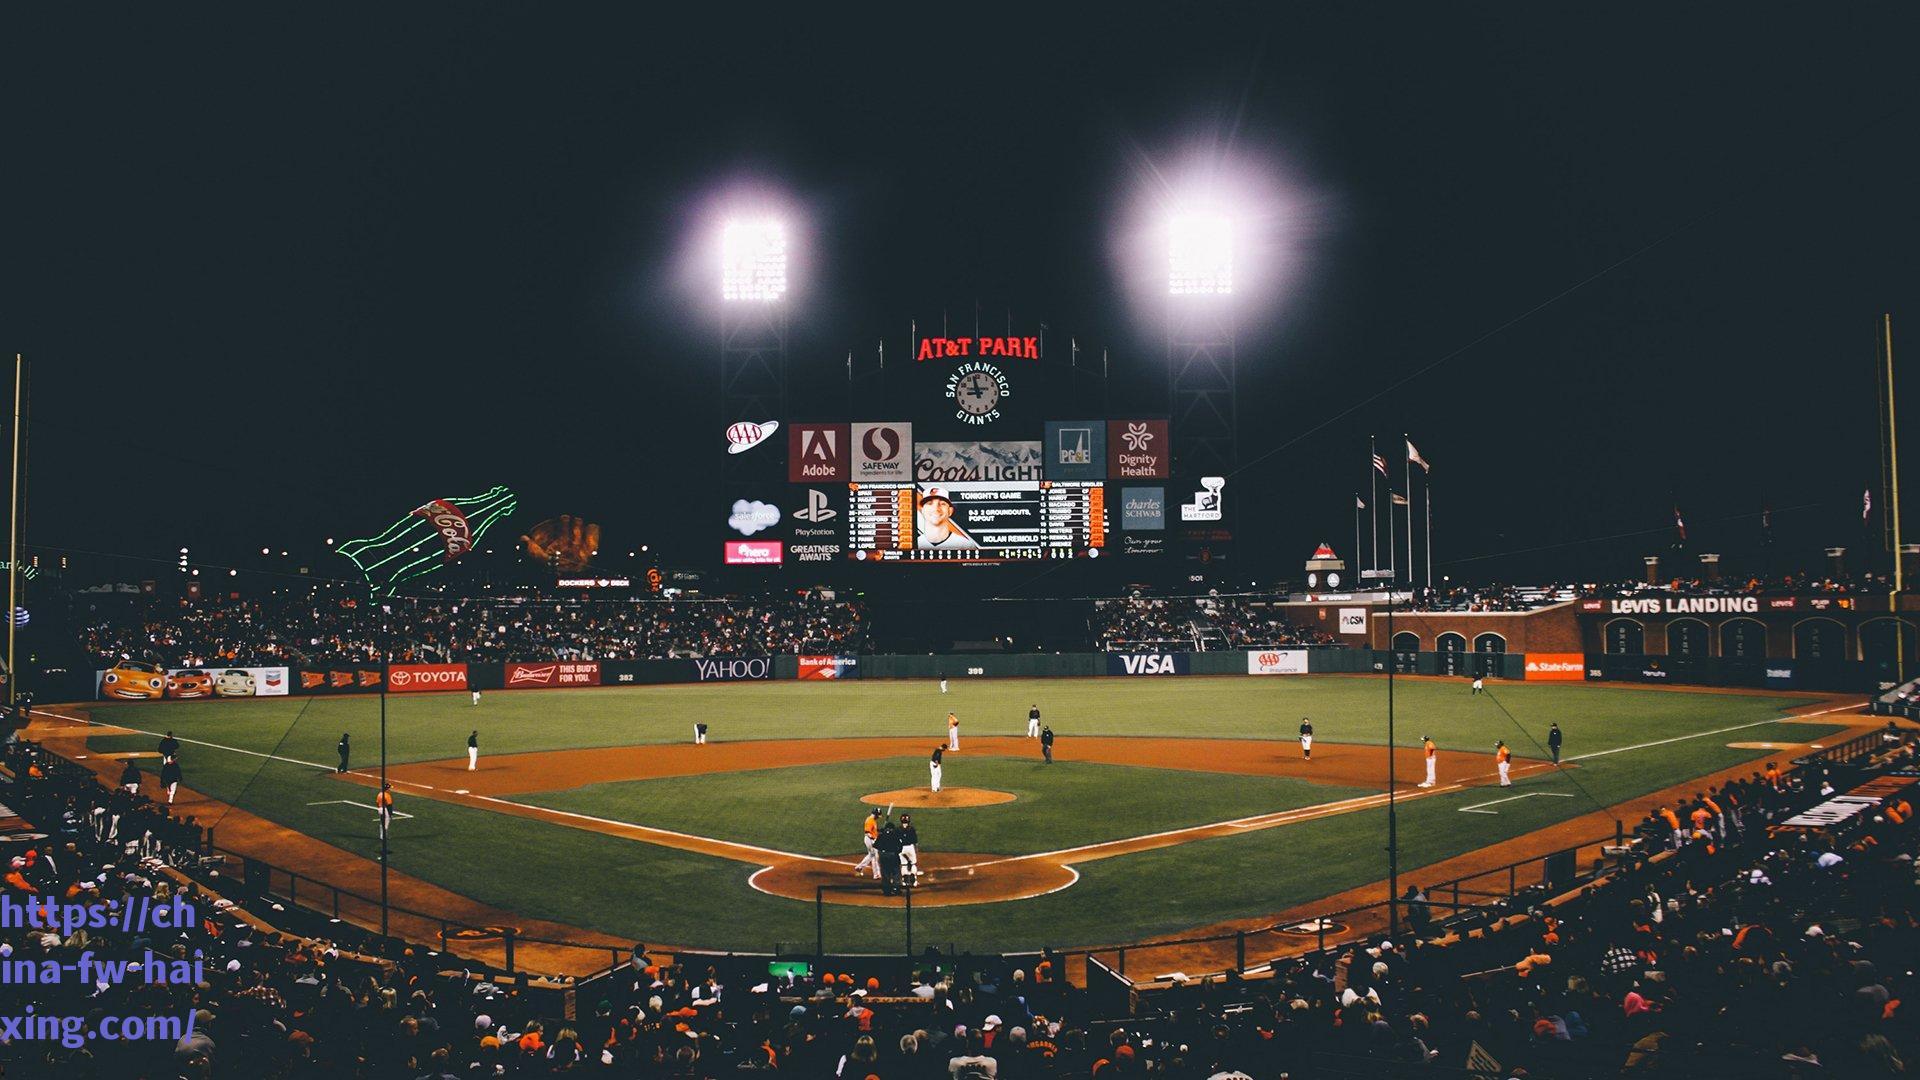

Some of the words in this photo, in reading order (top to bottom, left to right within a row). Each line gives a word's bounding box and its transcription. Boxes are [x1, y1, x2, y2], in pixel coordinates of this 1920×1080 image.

[917, 338, 972, 360] AT&T
[979, 337, 1038, 359] PARK
[946, 374, 960, 398] SAN
[957, 362, 1010, 397] FRANCISCO
[956, 409, 1000, 425] GIANTS
[1119, 454, 1157, 466] Dignity
[802, 465, 836, 476] Adobe
[862, 462, 900, 470] SAFEWAY
[916, 458, 981, 481] Coors
[984, 465, 1044, 480] LIGHT
[1121, 466, 1156, 476] Health
[1125, 499, 1160, 510] charles
[1125, 510, 1161, 518] SCHWAB
[795, 529, 834, 537] PlayStation
[790, 545, 840, 553] GREATNESS
[799, 553, 832, 561] AWAITS
[558, 579, 595, 587] DOCKERS
[610, 579, 630, 587] DECK
[1666, 597, 1758, 613] LANDING
[1349, 616, 1364, 625] CSN
[800, 658, 818, 666] Bank
[819, 658, 827, 666] of
[826, 658, 856, 666] America
[1118, 654, 1175, 674] VISA
[559, 665, 575, 673] THIS
[576, 664, 597, 673] BUD'S
[695, 658, 770, 680] YAHOO!
[413, 671, 466, 683] TOYOTA
[559, 674, 573, 682] FOR
[574, 674, 591, 682] YOU.
